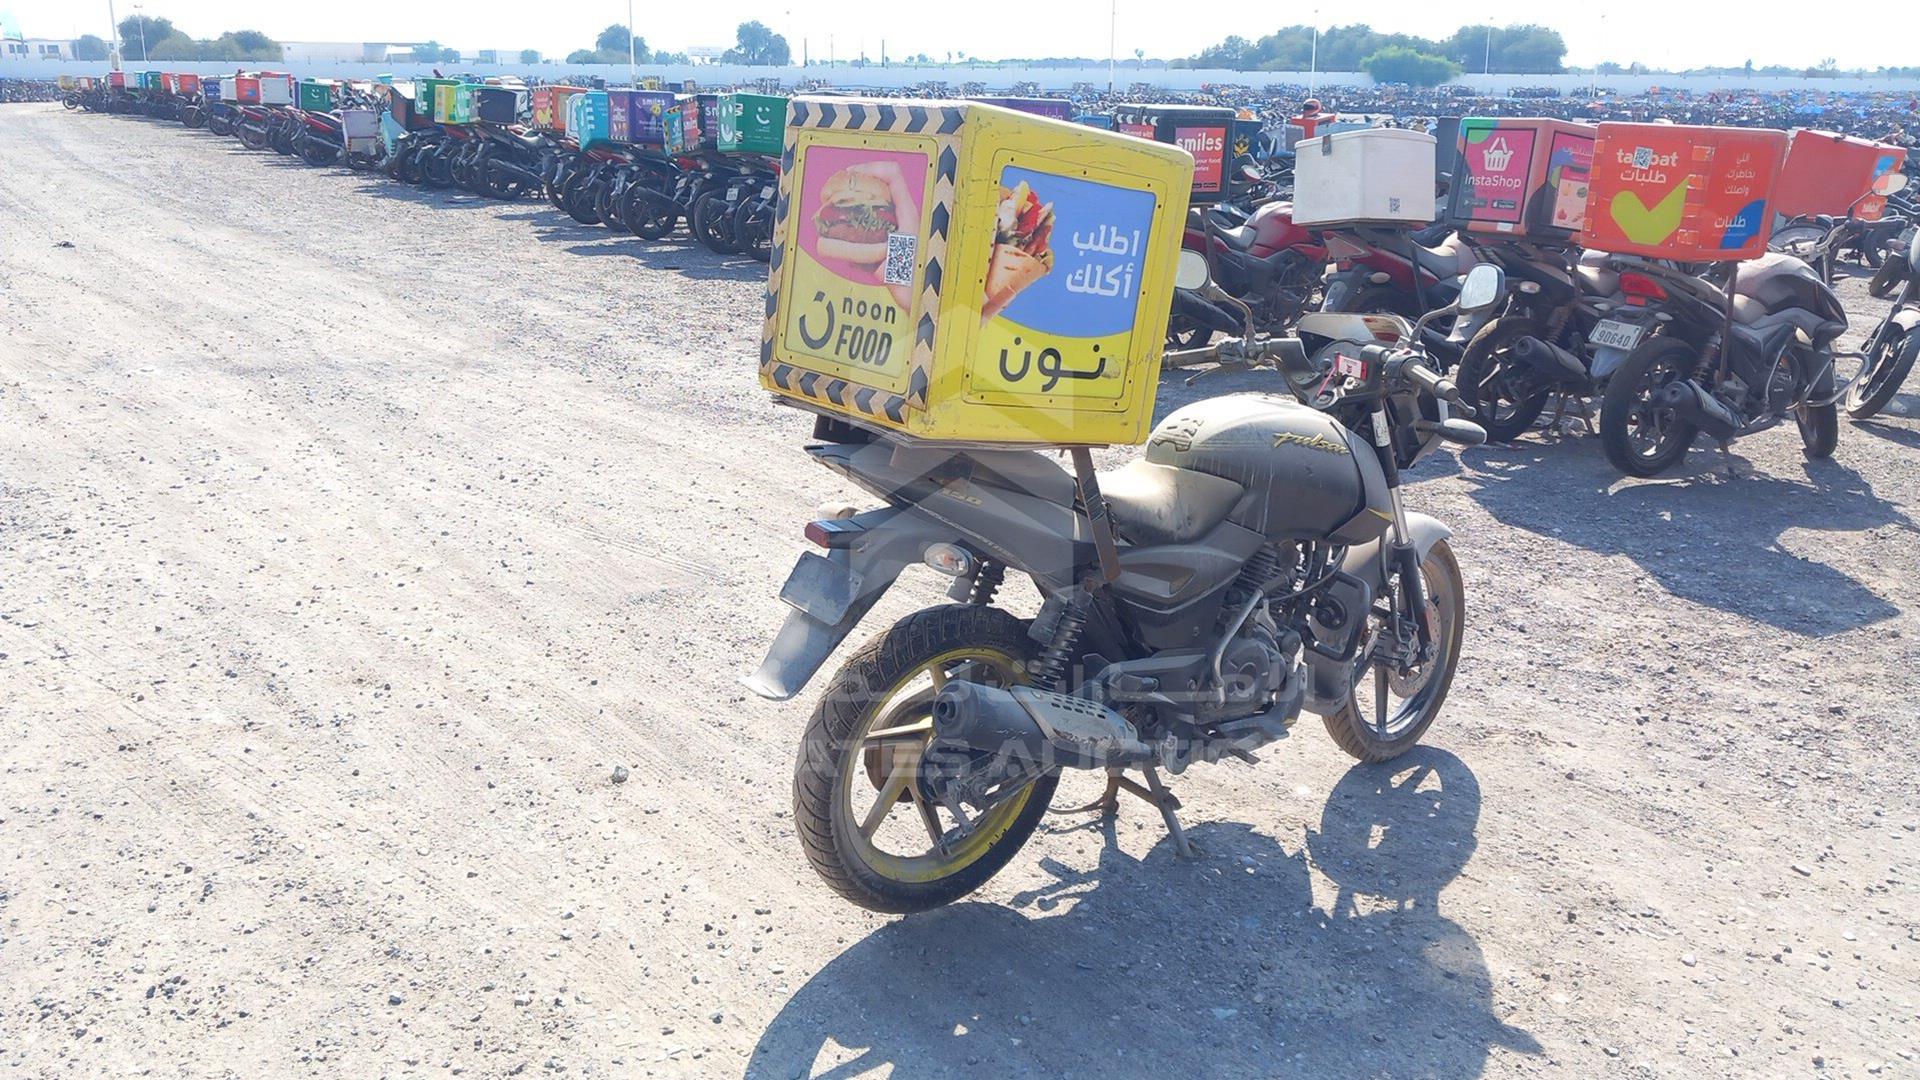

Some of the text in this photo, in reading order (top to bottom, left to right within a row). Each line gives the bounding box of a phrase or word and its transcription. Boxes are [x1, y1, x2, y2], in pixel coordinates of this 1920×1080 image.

[1175, 132, 1223, 152] smiles
[1616, 148, 1679, 167] tabat
[1464, 173, 1522, 190] InstaShop
[1620, 168, 1666, 186] طلبات
[1714, 214, 1746, 232] طلبات
[1073, 224, 1140, 257] اطلب
[1066, 262, 1134, 299] أكلك
[842, 297, 896, 325] noon
[834, 324, 893, 366] FOOD
[1597, 330, 1632, 347] 90640
[1000, 336, 1106, 393] نون
